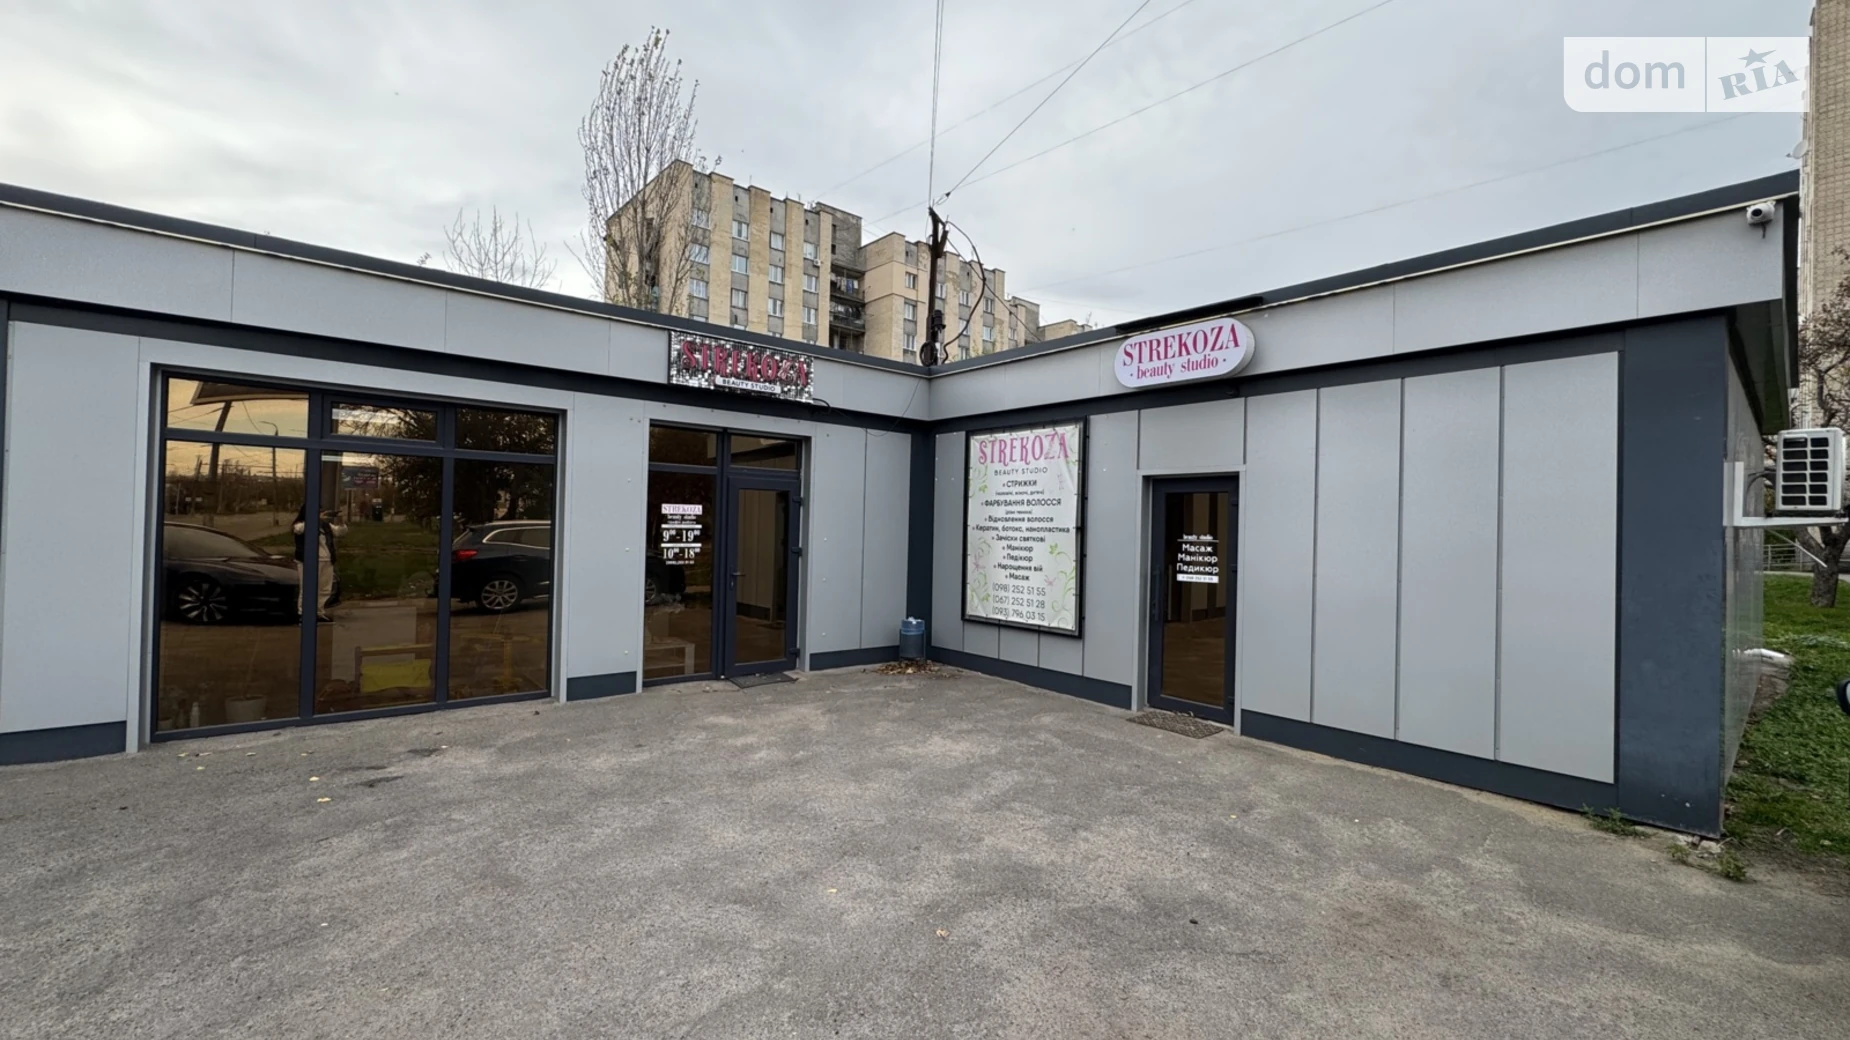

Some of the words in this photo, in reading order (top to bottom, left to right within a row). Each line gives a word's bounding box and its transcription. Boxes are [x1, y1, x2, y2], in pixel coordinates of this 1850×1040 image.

[1122, 323, 1240, 367] STREKOZA
[682, 340, 808, 387] STREKOZA
[1136, 361, 1175, 379] beauty
[1180, 354, 1219, 373] studio
[722, 379, 749, 388] BEAUTY
[750, 382, 776, 391] STUDIO
[978, 432, 1069, 467] STREKOZA
[994, 468, 1019, 476] BEAUTY
[1021, 467, 1048, 475] STUDIO
[1006, 480, 1037, 488] СТРИЖКИ
[984, 499, 1025, 507] ФАРБУВАННЯ
[1026, 498, 1061, 507] ВОЛОССЯ
[1006, 545, 1034, 553] Манікюр
[1182, 543, 1213, 552] Масаж
[1177, 553, 1218, 564] Манікюр
[1176, 563, 1219, 574] Педикюр
[992, 582, 1010, 593] (098)
[1011, 585, 1025, 594] 252
[1026, 586, 1035, 595] 51
[1036, 587, 1046, 597] 55
[992, 594, 1010, 605] (067)
[1011, 597, 1025, 607] 252
[1026, 598, 1034, 607] 51
[1035, 599, 1045, 609] 28
[1011, 608, 1024, 619] 796
[1025, 611, 1036, 620] 03
[1037, 612, 1046, 622] 15
